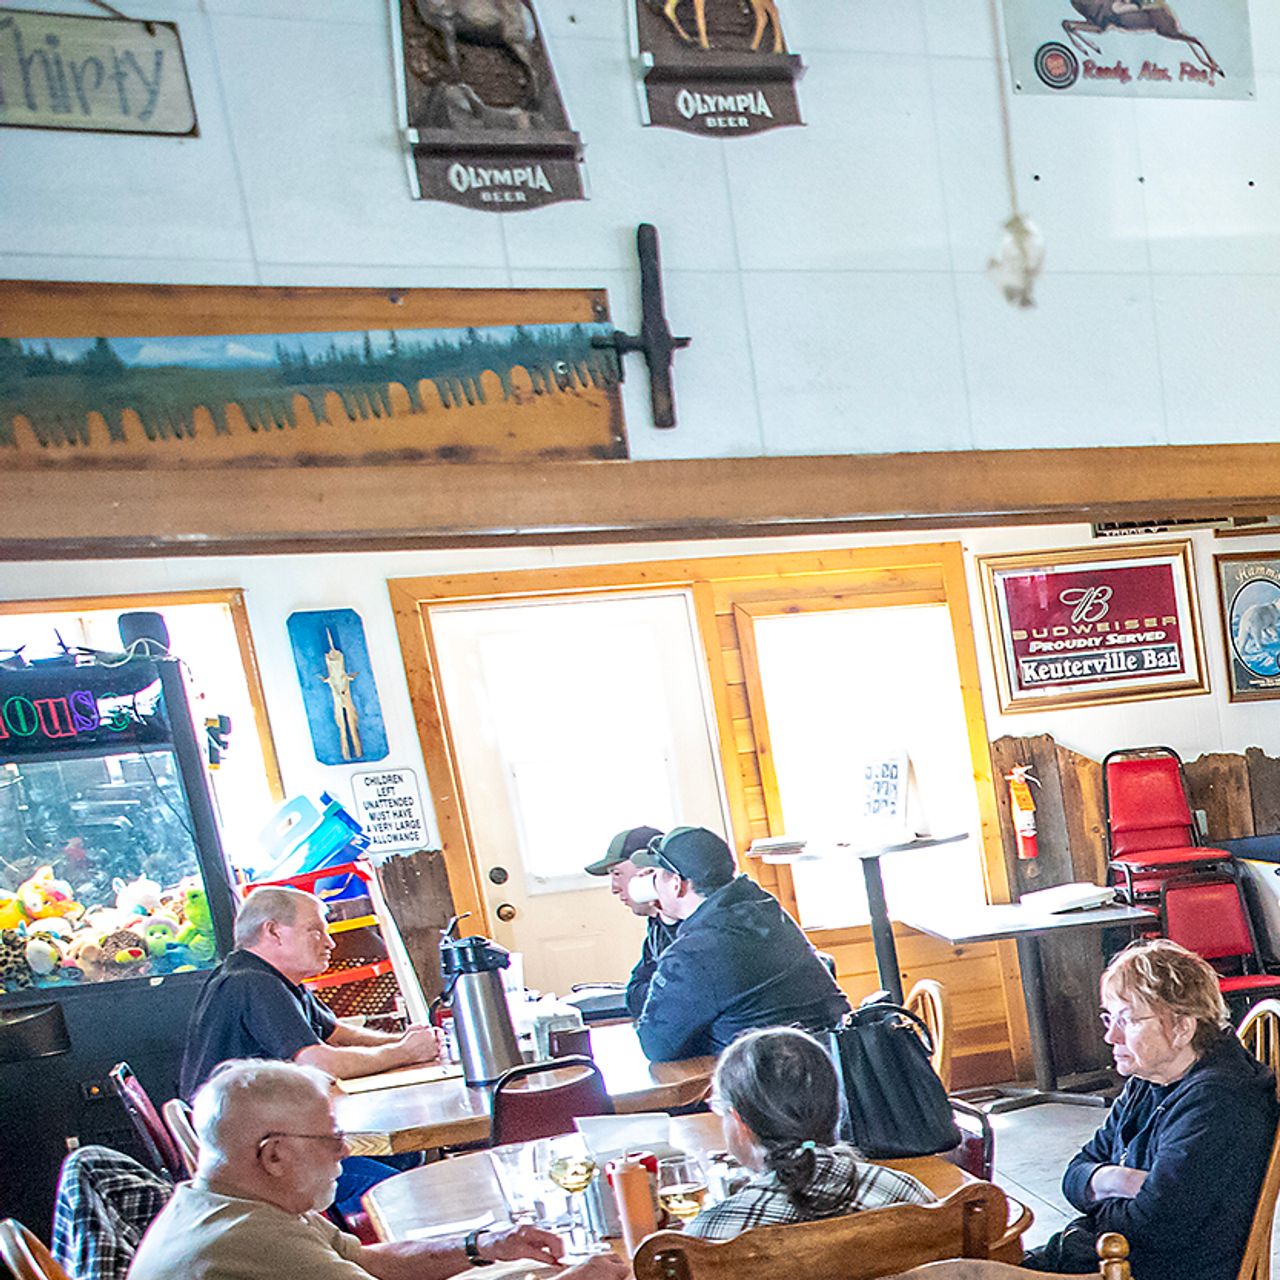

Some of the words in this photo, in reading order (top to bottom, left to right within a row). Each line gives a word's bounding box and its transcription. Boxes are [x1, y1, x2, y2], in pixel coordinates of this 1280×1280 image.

[677, 88, 774, 120] OLYMPIA
[705, 116, 750, 128] BEER
[448, 162, 553, 194] OLYMPIA
[480, 191, 527, 203] BEER
[1012, 615, 1176, 641] BUDWEISER
[1029, 636, 1103, 654] PROUDLY
[1105, 630, 1167, 645] SERVED
[1022, 654, 1138, 683] Keuterville
[1143, 649, 1179, 672] Bar
[364, 774, 404, 787] CHILDREN
[377, 786, 395, 797] LEFT
[363, 796, 414, 811] UNATTENDED
[369, 810, 390, 821] MUST
[392, 808, 412, 819] HAVE
[373, 822, 392, 833] VERY
[395, 819, 421, 831] LARGE
[373, 831, 420, 845] ALLOWANCE
